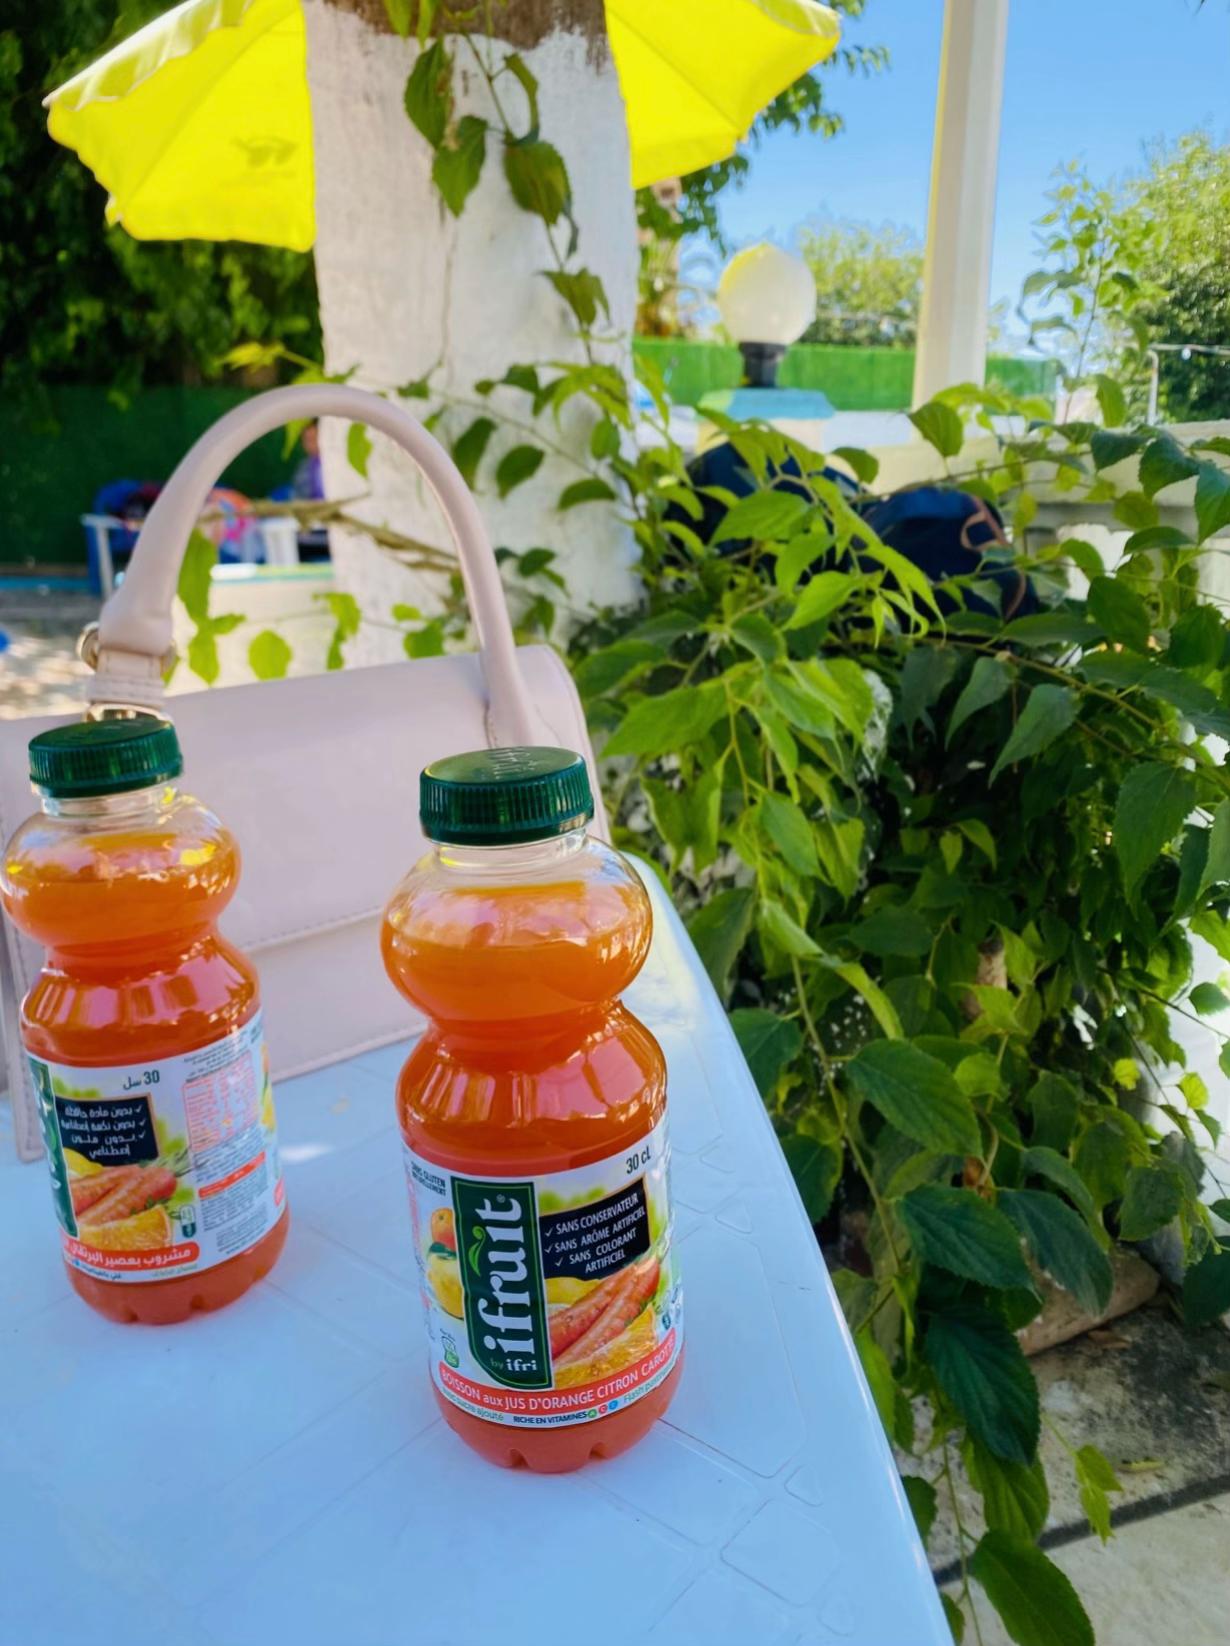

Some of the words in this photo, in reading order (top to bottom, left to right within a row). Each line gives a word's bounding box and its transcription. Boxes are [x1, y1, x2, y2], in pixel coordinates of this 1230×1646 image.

[625, 1153, 639, 1175] 30
[556, 1219, 580, 1235] SANS
[580, 1192, 639, 1229] CONSERVATEUR
[554, 1238, 578, 1253] SANS
[581, 1226, 610, 1247] ARÔME
[612, 1206, 645, 1233] ARTIFICIEL
[143, 1246, 192, 1266] مشروب
[569, 1250, 592, 1265] SANS
[595, 1227, 637, 1256] COLORANT
[105, 1254, 141, 1269] بعصير
[585, 1249, 626, 1274] ARTIFICIEL
[506, 1358, 537, 1371] ifri
[442, 1368, 481, 1400] BOISSON
[482, 1394, 504, 1407] aux
[504, 1396, 526, 1411] JUS
[529, 1390, 595, 1410] D'ORANGE
[597, 1370, 639, 1399] CITRON
[513, 1415, 536, 1424] RICHE
[547, 1411, 588, 1424] VITAMINES
